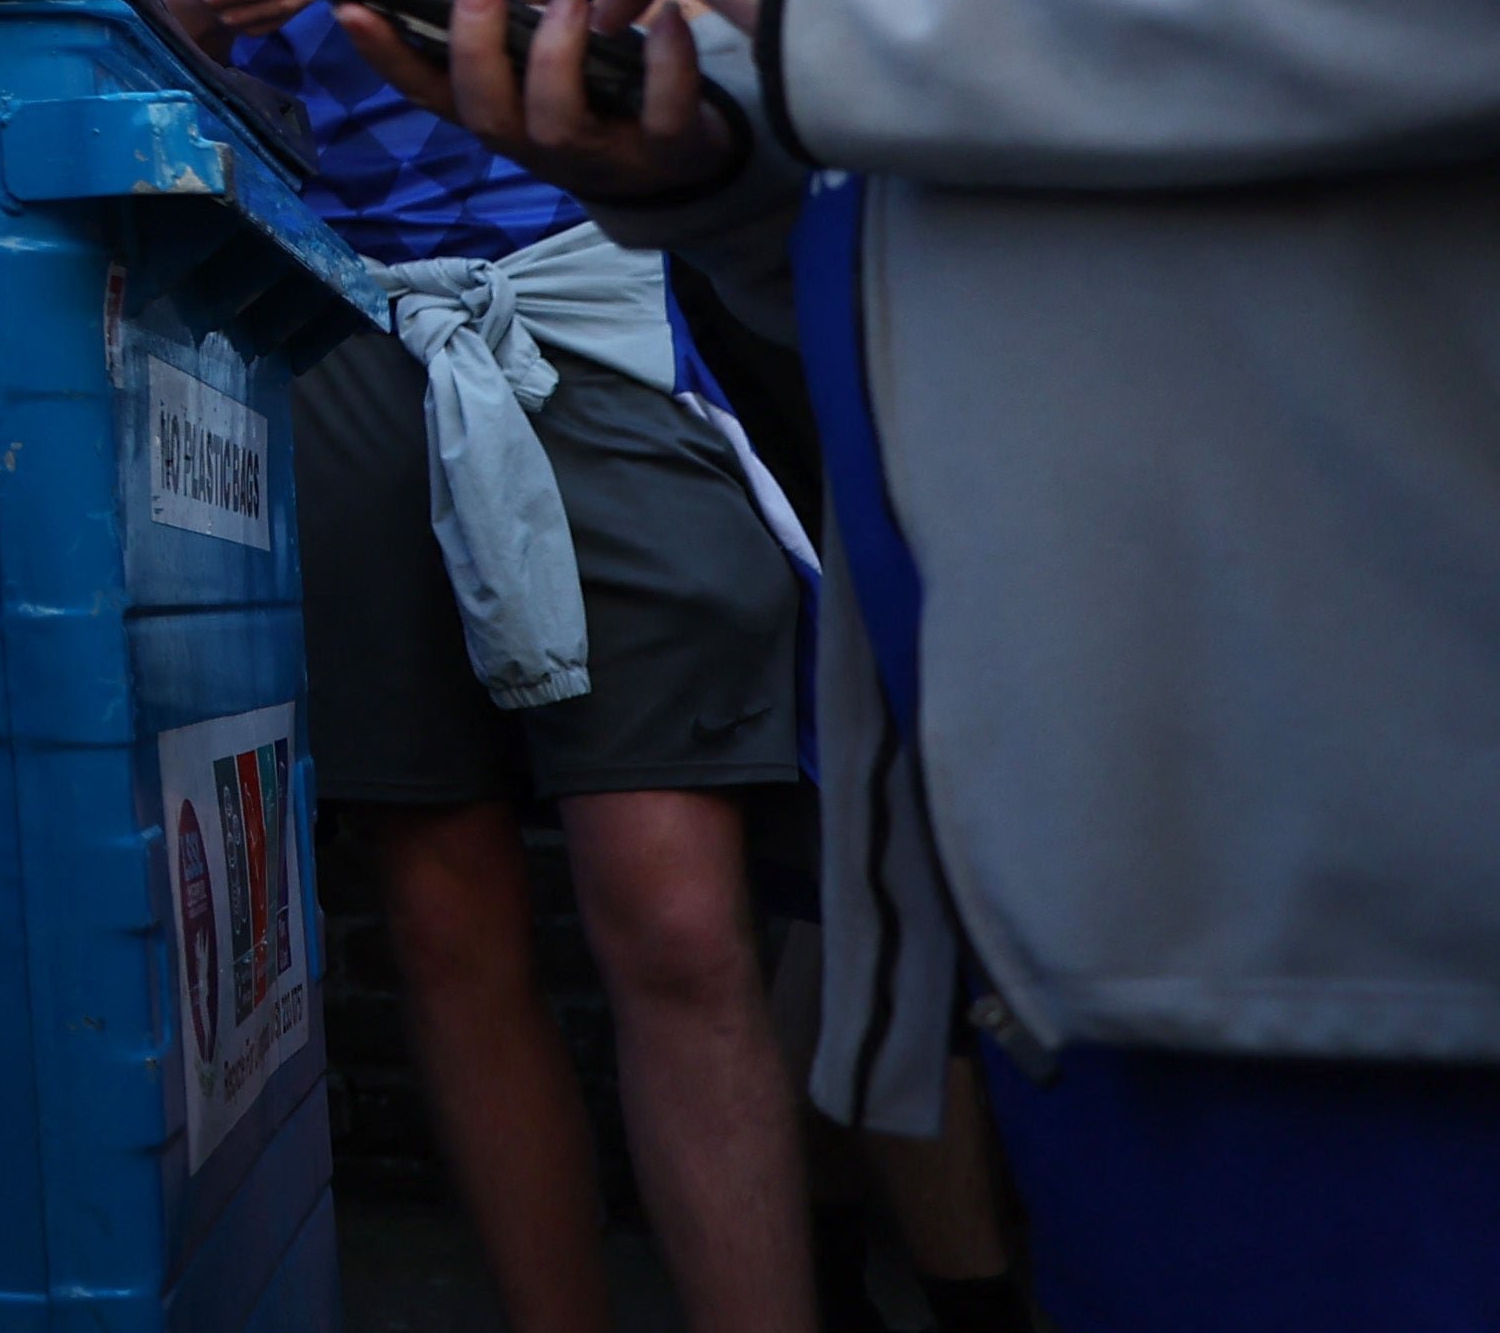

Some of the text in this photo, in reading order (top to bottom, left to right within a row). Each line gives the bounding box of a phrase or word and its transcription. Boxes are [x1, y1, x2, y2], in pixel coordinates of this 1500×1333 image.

[160, 410, 260, 521] NO PLASTIC BAGS
